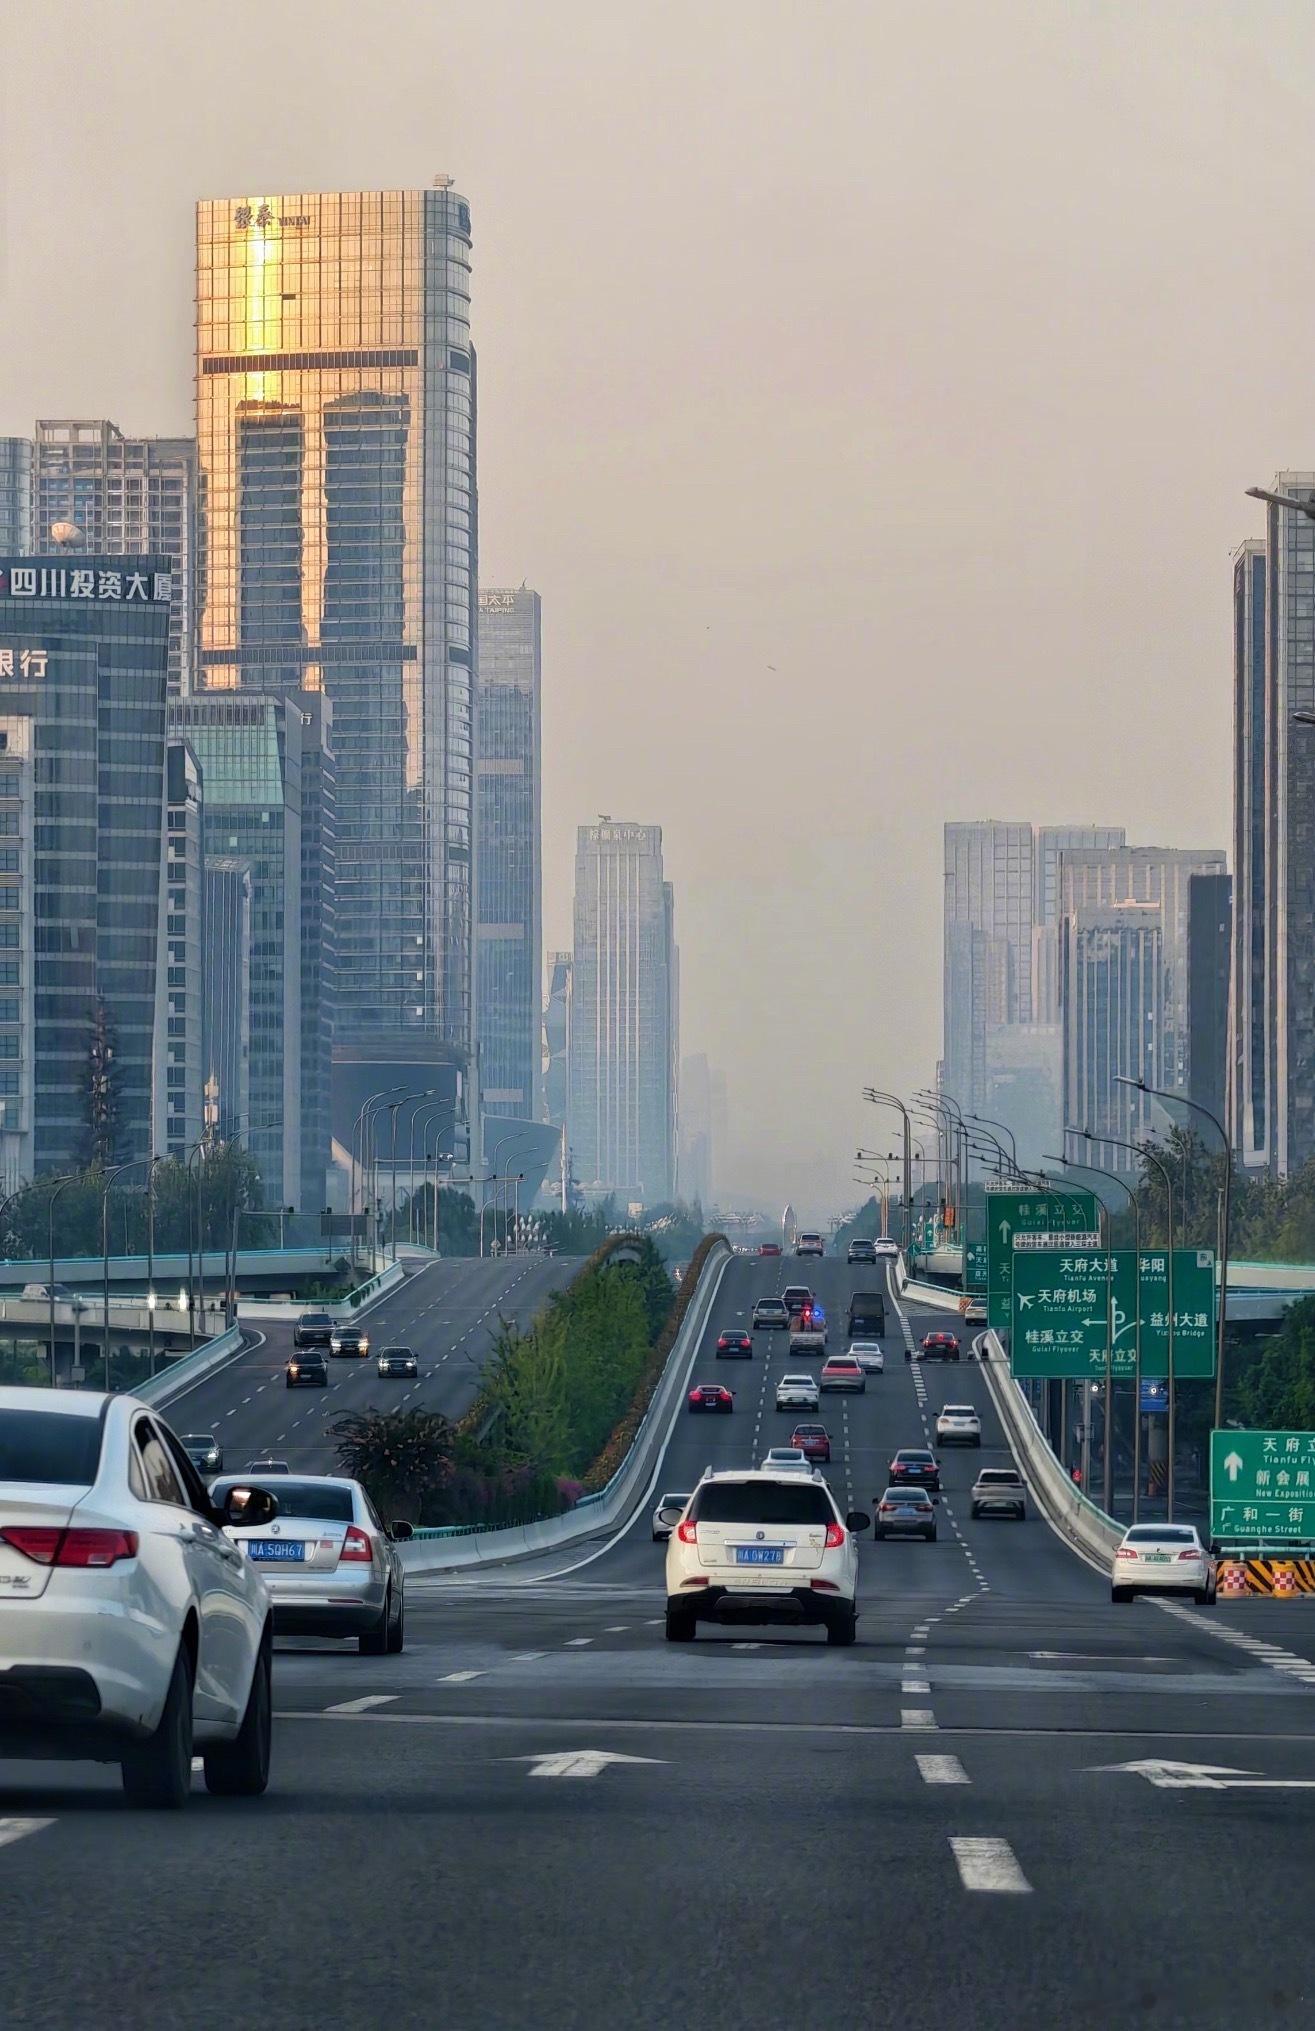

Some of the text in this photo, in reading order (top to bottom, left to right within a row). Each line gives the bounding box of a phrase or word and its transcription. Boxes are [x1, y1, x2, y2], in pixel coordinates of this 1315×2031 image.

[10, 568, 172, 601] 四川投资大厦
[1059, 1257, 1165, 1273] 天府大道 华阳
[1140, 1275, 1168, 1283] uayang
[1037, 1288, 1097, 1304] 天府机场
[1067, 1305, 1093, 1314] Airport
[1149, 1311, 1209, 1328] 益州大道
[1024, 1329, 1085, 1345] 桂溪立交
[1181, 1329, 1206, 1339] Bridge
[1263, 1454, 1298, 1464] Tianfu
[1255, 1469, 1310, 1487] 新会展
[1255, 1488, 1315, 1499] New Expositio
[1220, 1505, 1304, 1522] 广和一街
[1233, 1524, 1302, 1535] Guanghe Street
